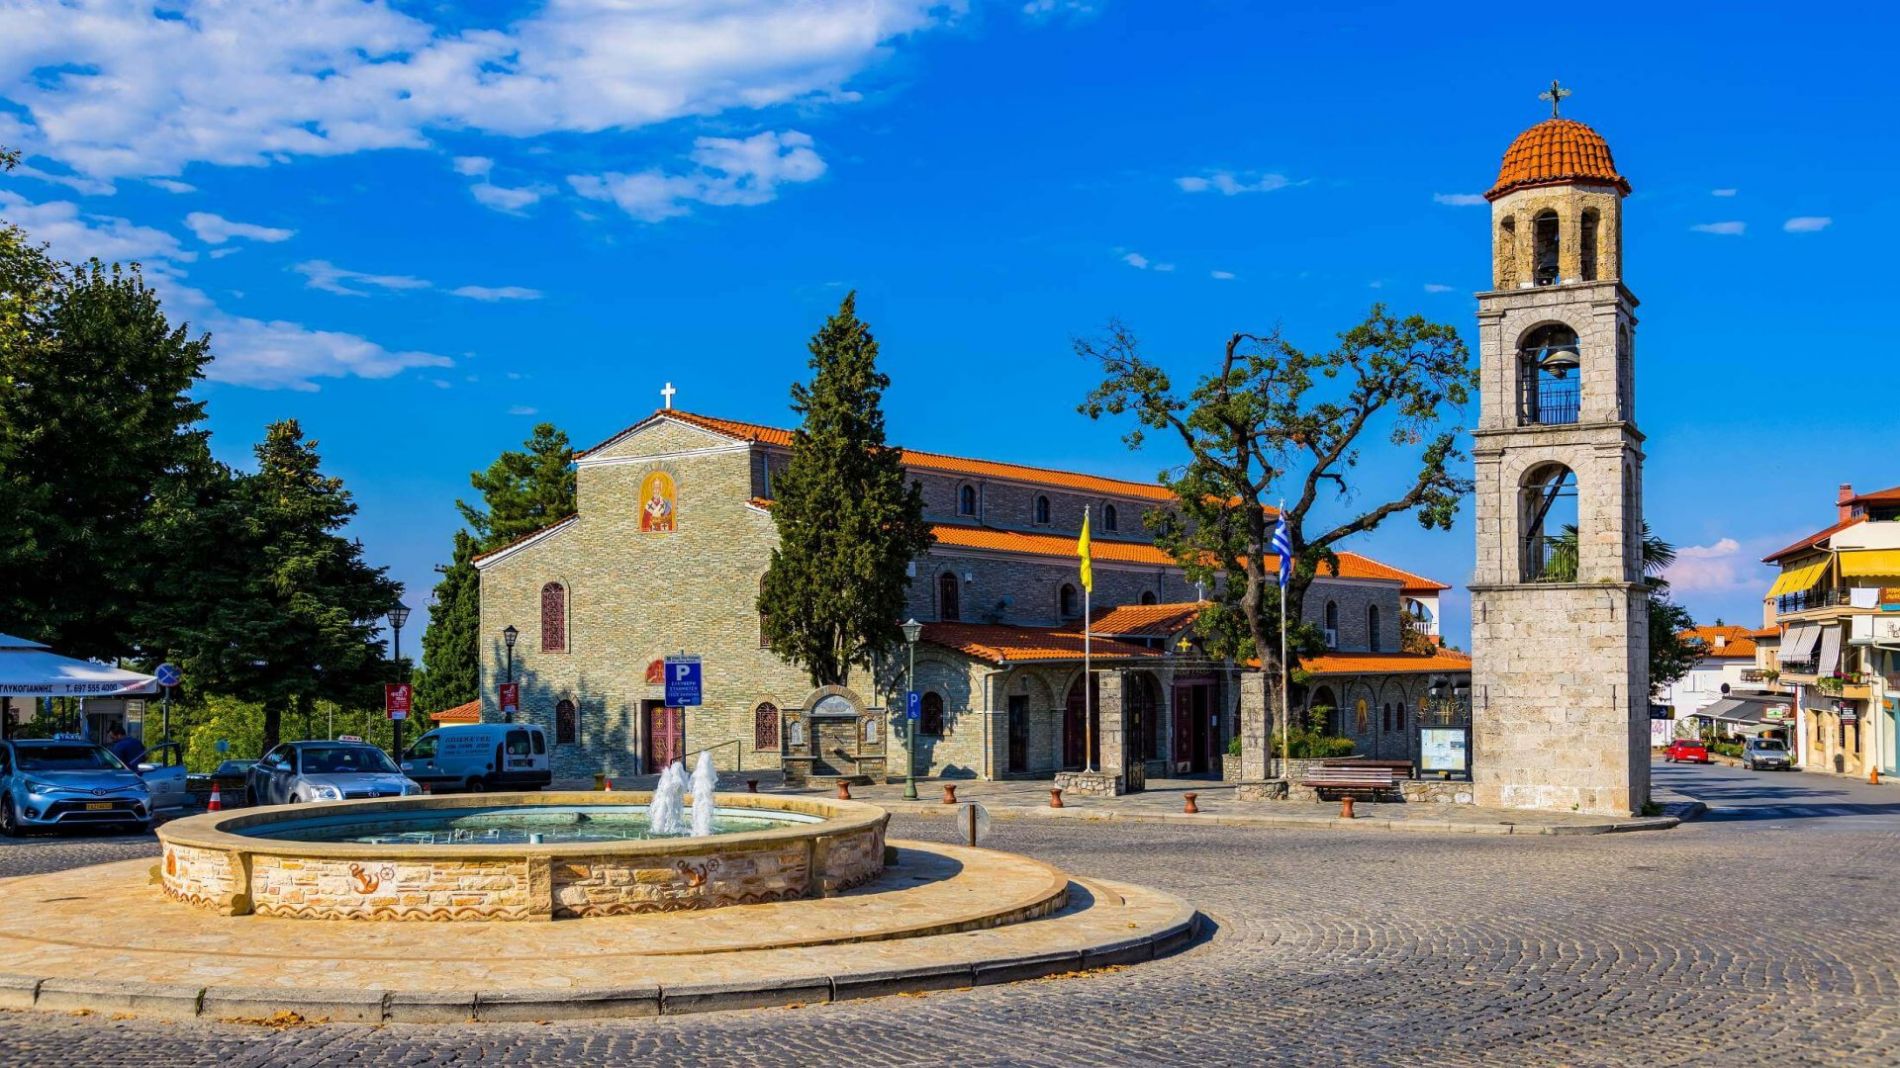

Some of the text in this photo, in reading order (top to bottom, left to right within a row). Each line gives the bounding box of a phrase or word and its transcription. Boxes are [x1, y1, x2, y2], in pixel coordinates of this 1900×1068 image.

[676, 665, 690, 680] P
[87, 684, 100, 692] 555
[101, 683, 118, 692] 4000
[911, 694, 918, 707] P
